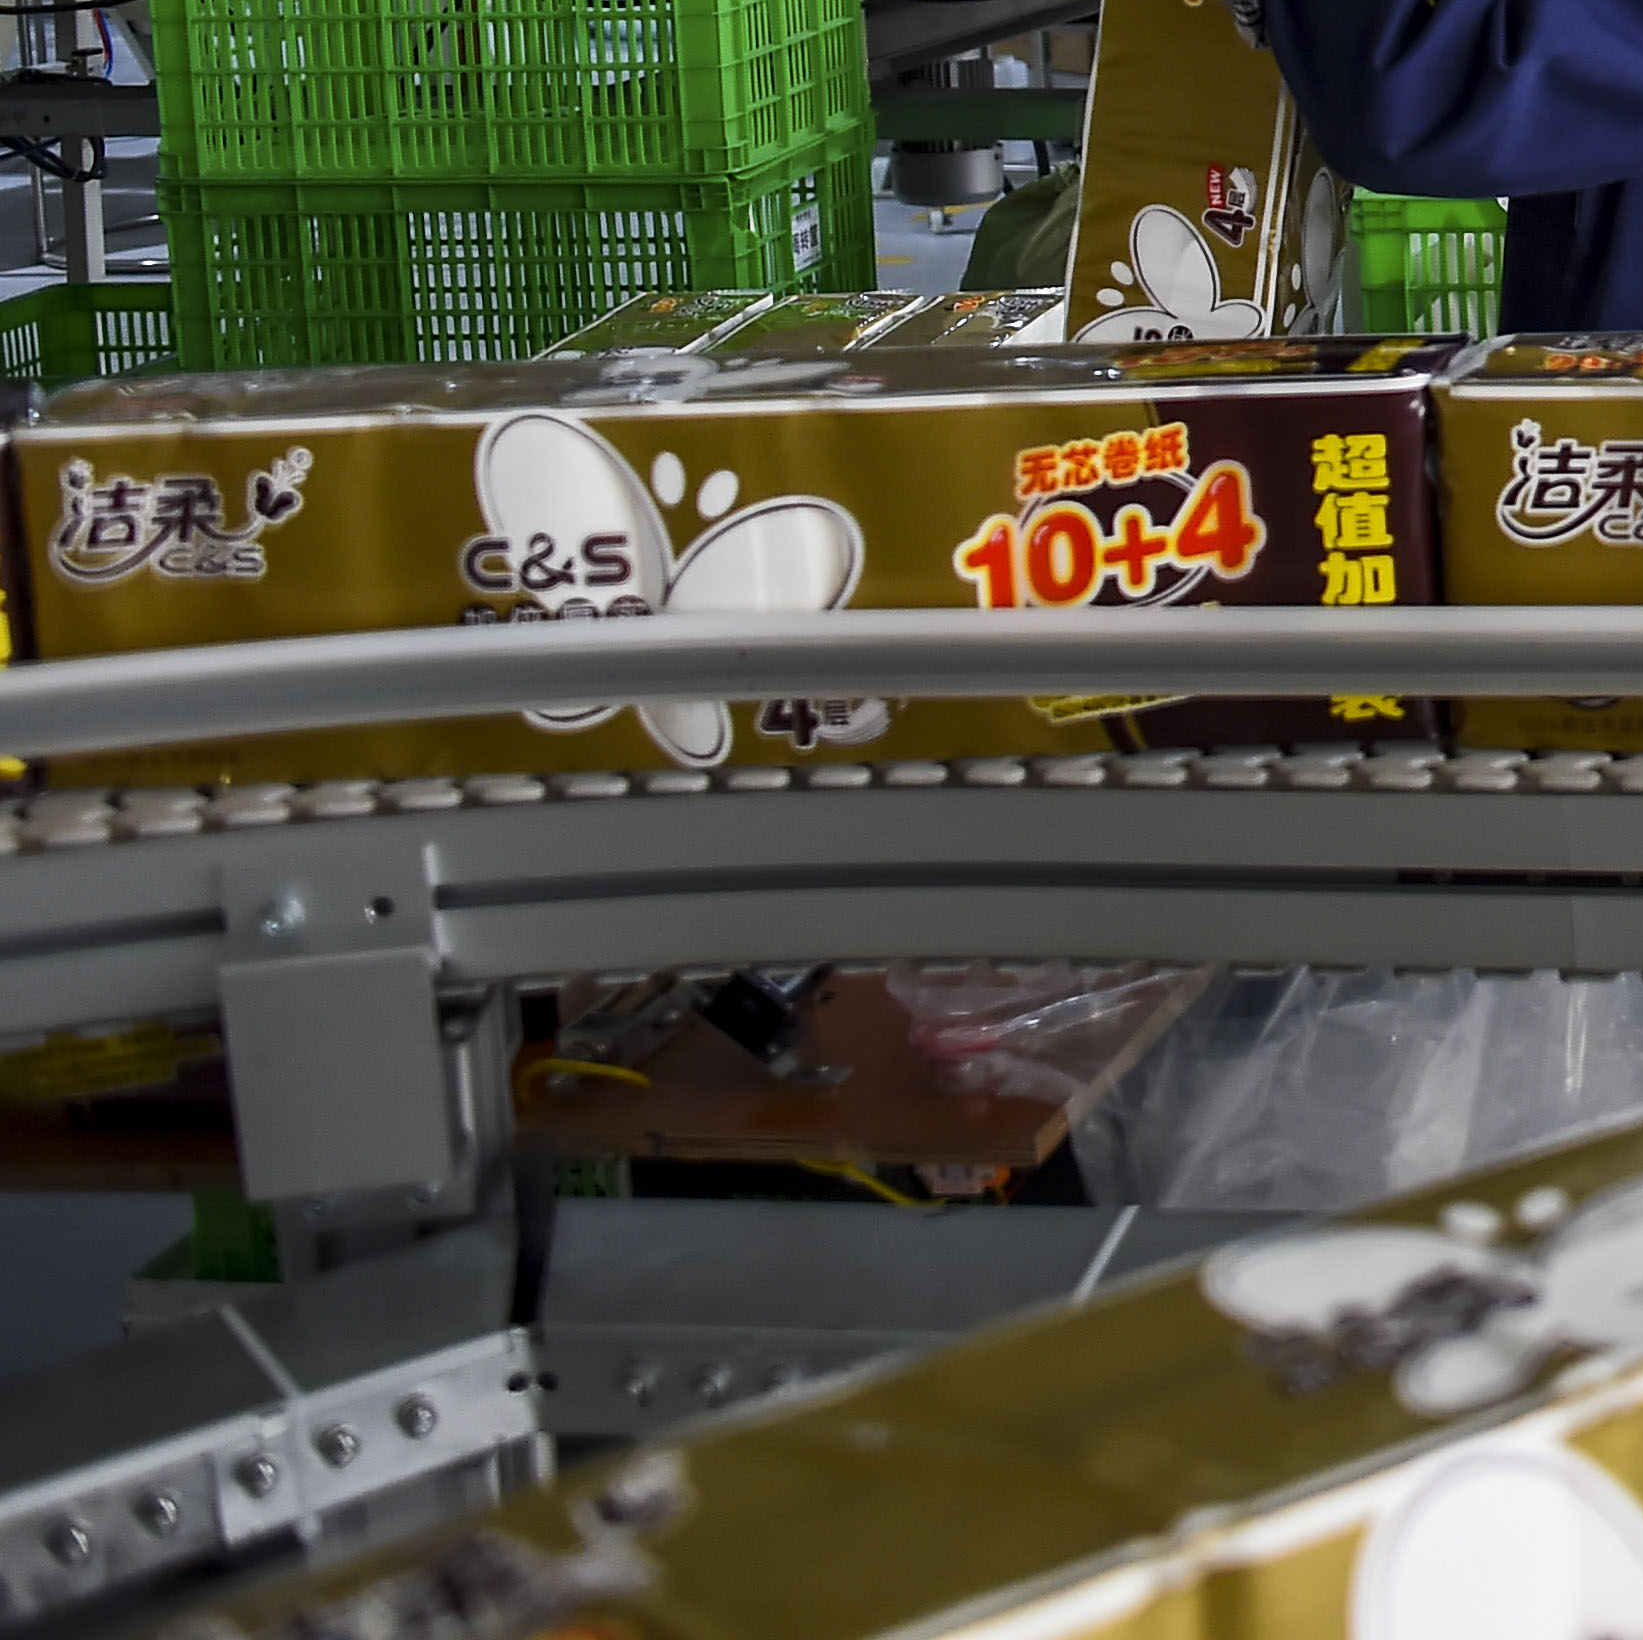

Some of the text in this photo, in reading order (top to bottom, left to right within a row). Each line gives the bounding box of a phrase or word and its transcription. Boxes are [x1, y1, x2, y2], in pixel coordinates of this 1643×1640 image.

[1208, 167, 1223, 206] NEW
[1018, 424, 1188, 498] 无芯卷纸
[55, 463, 228, 580] 洁柔
[959, 466, 1264, 608] 10+4
[156, 543, 266, 577] C&S
[462, 532, 632, 591] C&S
